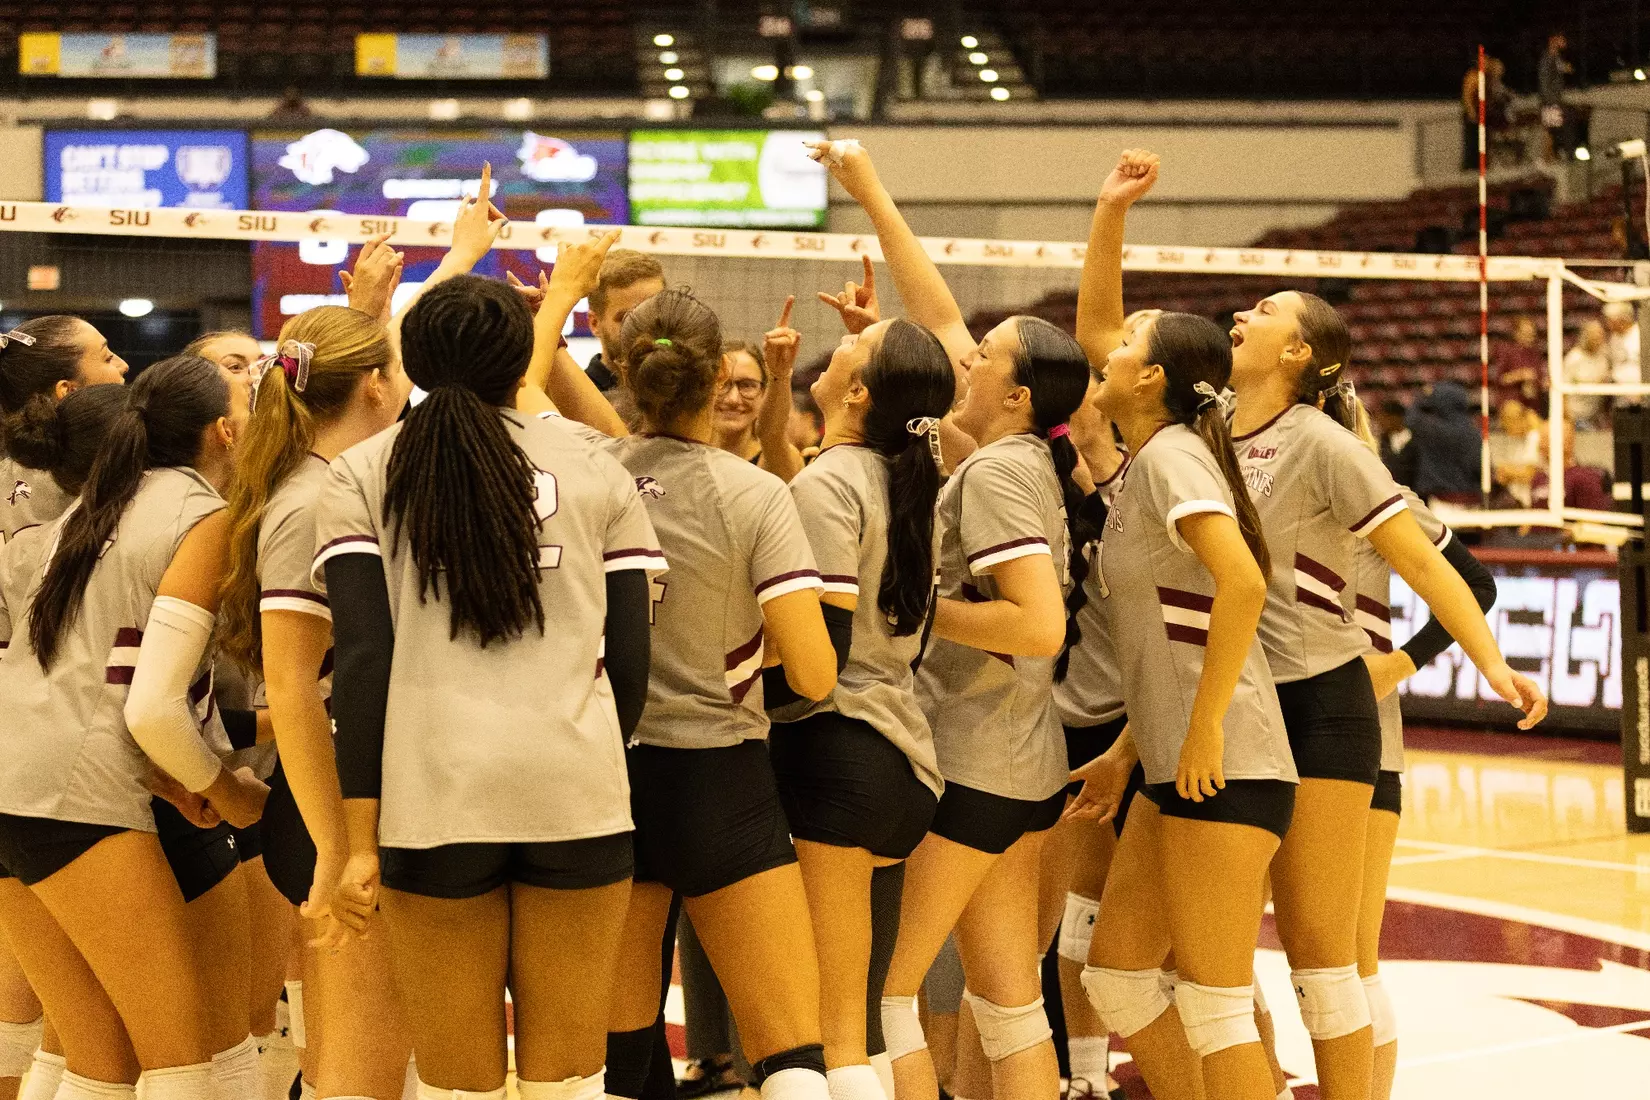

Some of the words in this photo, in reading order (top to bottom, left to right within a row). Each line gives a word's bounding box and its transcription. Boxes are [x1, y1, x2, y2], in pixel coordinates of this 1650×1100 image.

[109, 209, 151, 227] SIU
[238, 214, 278, 232] SIU
[359, 219, 398, 236] SIU
